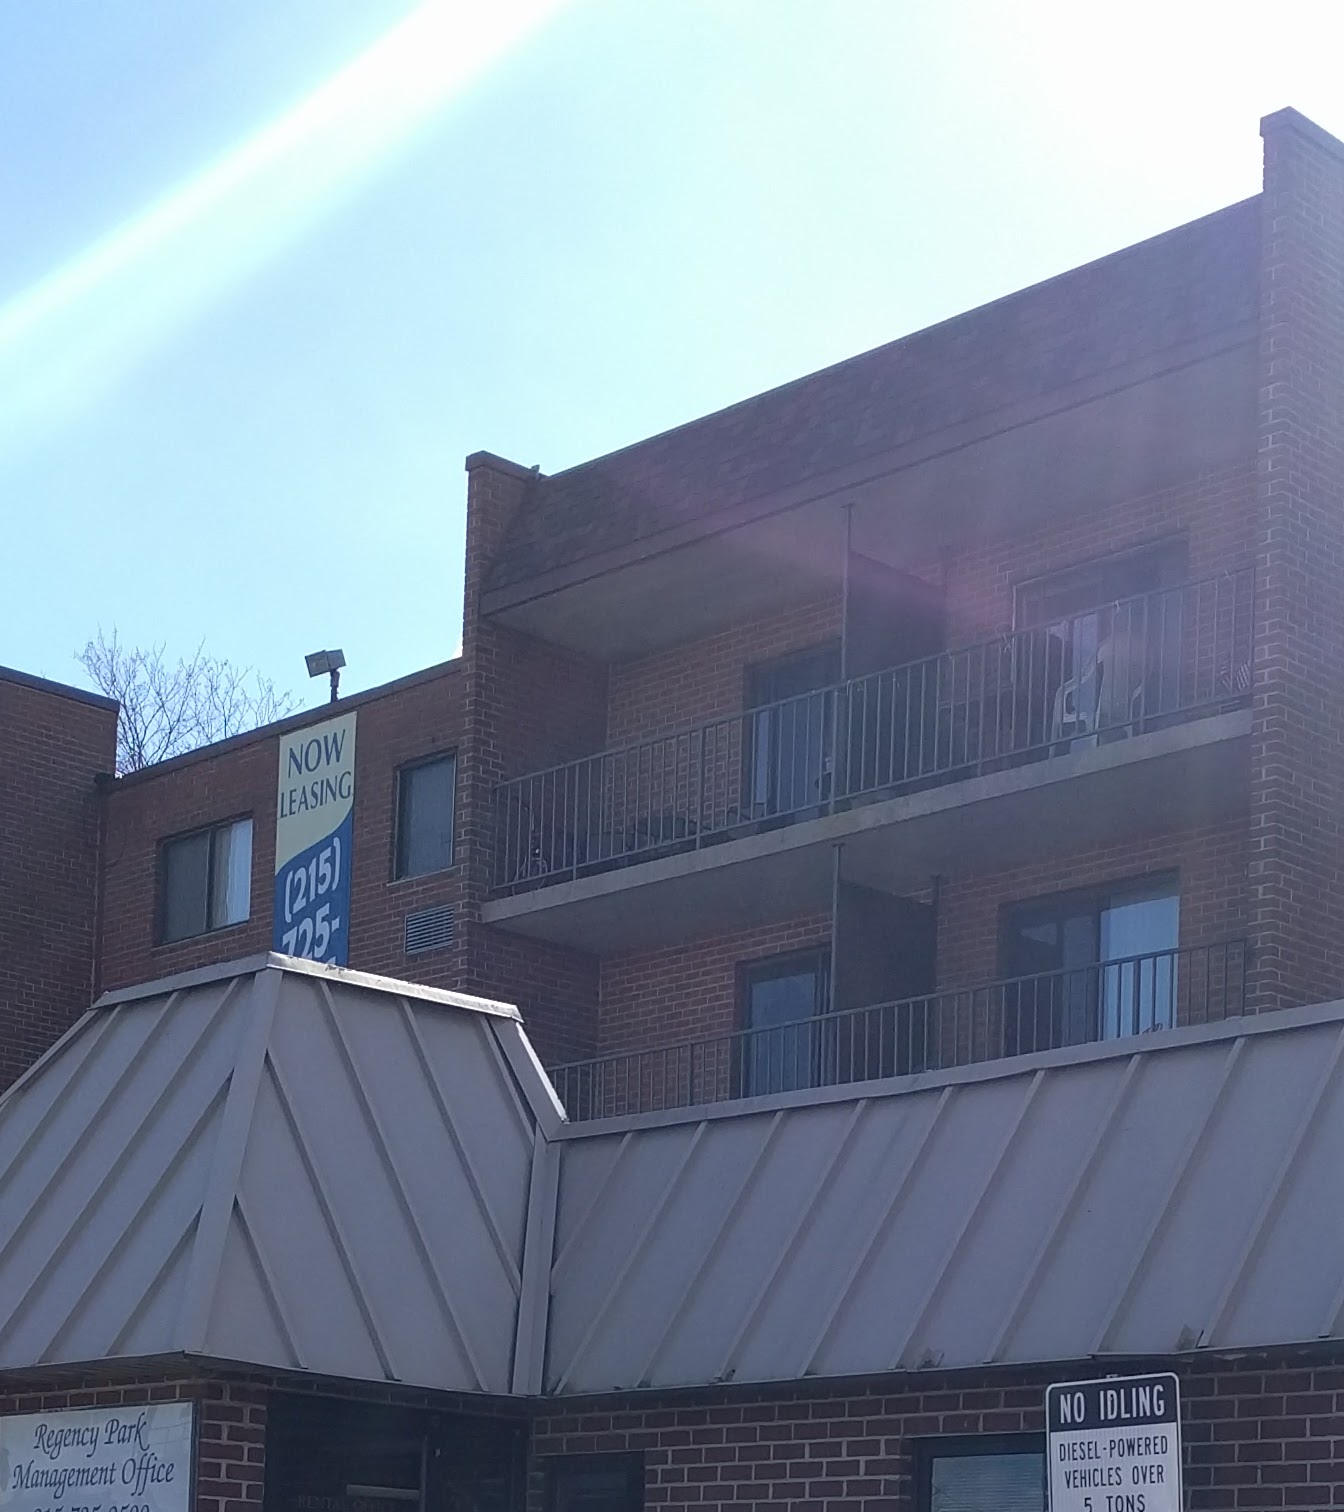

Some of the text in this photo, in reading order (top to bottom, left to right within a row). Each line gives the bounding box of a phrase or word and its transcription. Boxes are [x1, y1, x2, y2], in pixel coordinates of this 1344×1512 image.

[288, 728, 346, 779] NOW
[280, 770, 353, 819] LEASING
[285, 837, 341, 923] (215)
[282, 902, 340, 964] 725-
[1059, 1385, 1165, 1424] NO IDLING
[33, 1412, 151, 1460] Regency Park
[1059, 1435, 1168, 1462] DIESEL-POWERED
[11, 1452, 176, 1499] Management Office
[1065, 1464, 1165, 1489] VEHICLES OVER
